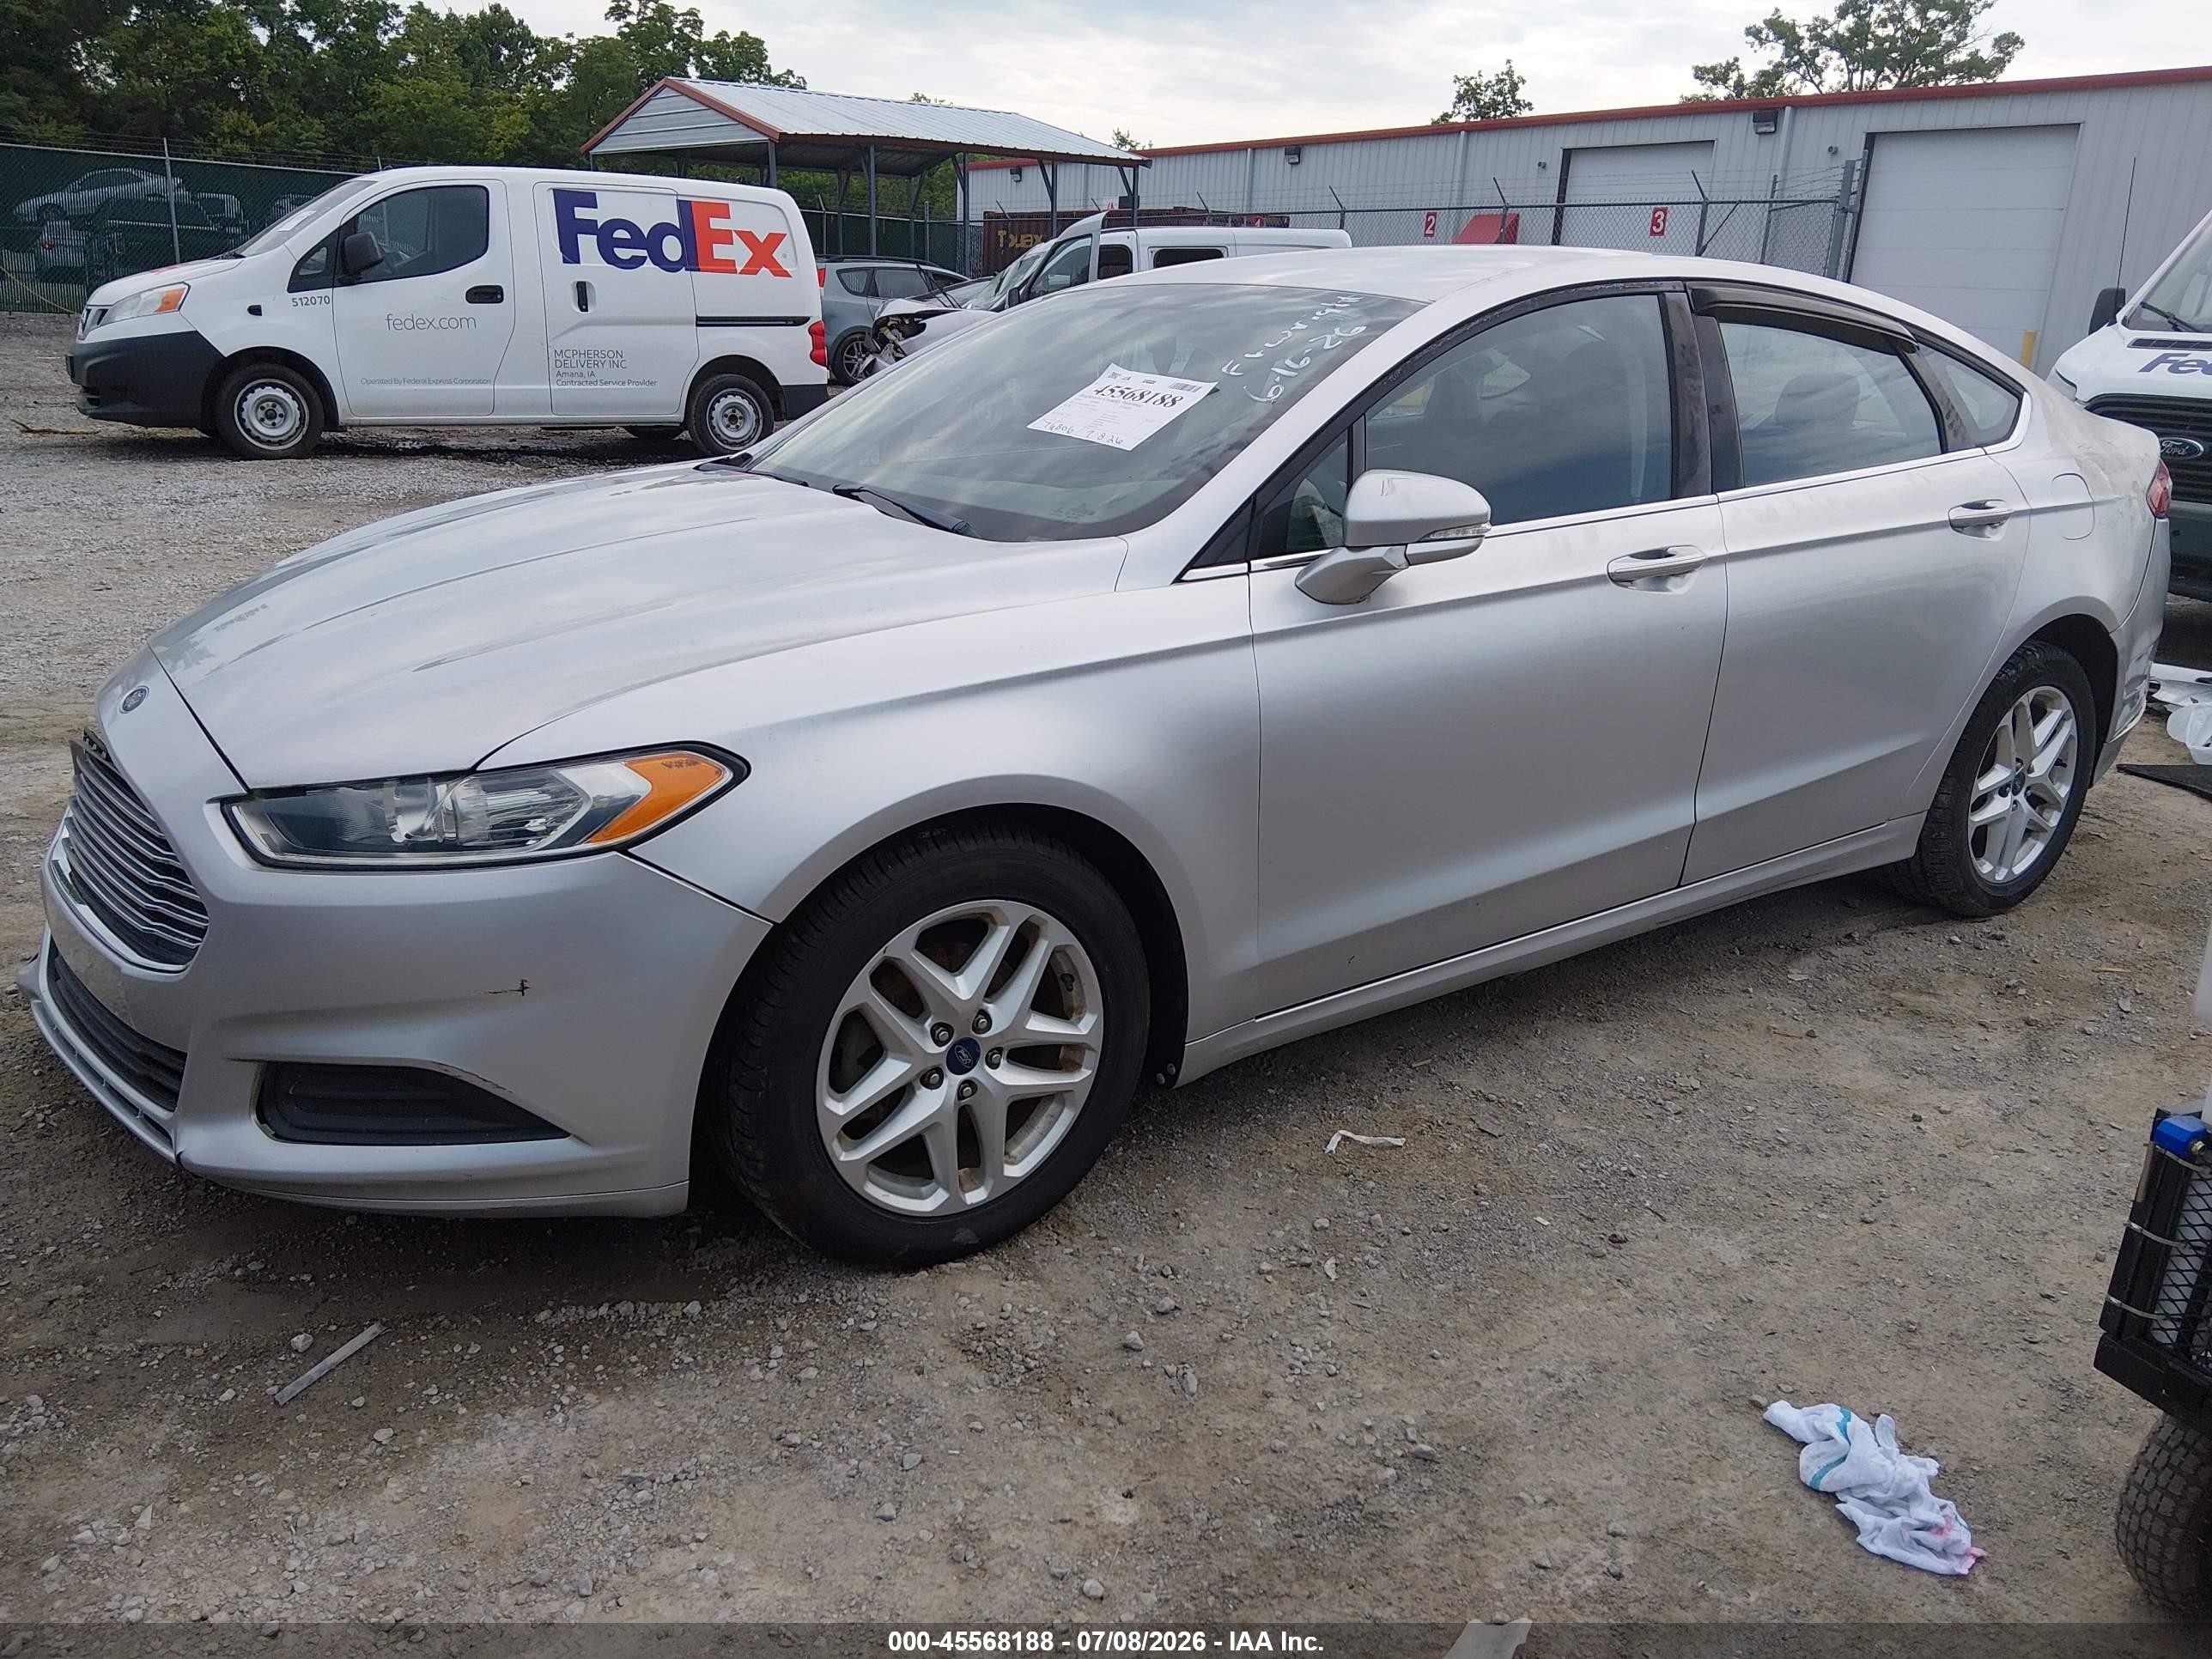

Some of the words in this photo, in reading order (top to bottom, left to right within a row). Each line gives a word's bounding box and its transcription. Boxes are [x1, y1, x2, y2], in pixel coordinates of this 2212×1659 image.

[1425, 215, 1435, 234] 2
[1652, 210, 1666, 234] 3
[553, 189, 792, 277] FedEx
[292, 295, 331, 307] 512070
[385, 313, 477, 331] fedex.com
[554, 349, 623, 359] MCPHERSON
[555, 359, 606, 368] DELIVERY
[609, 359, 628, 368] INC
[361, 377, 393, 386] Operated
[394, 377, 402, 386] By
[429, 377, 453, 386] Express
[453, 377, 491, 386] Corporation
[556, 370, 586, 379] Amana,
[1093, 384, 1184, 408] 45568188
[2160, 439, 2191, 456] Ford
